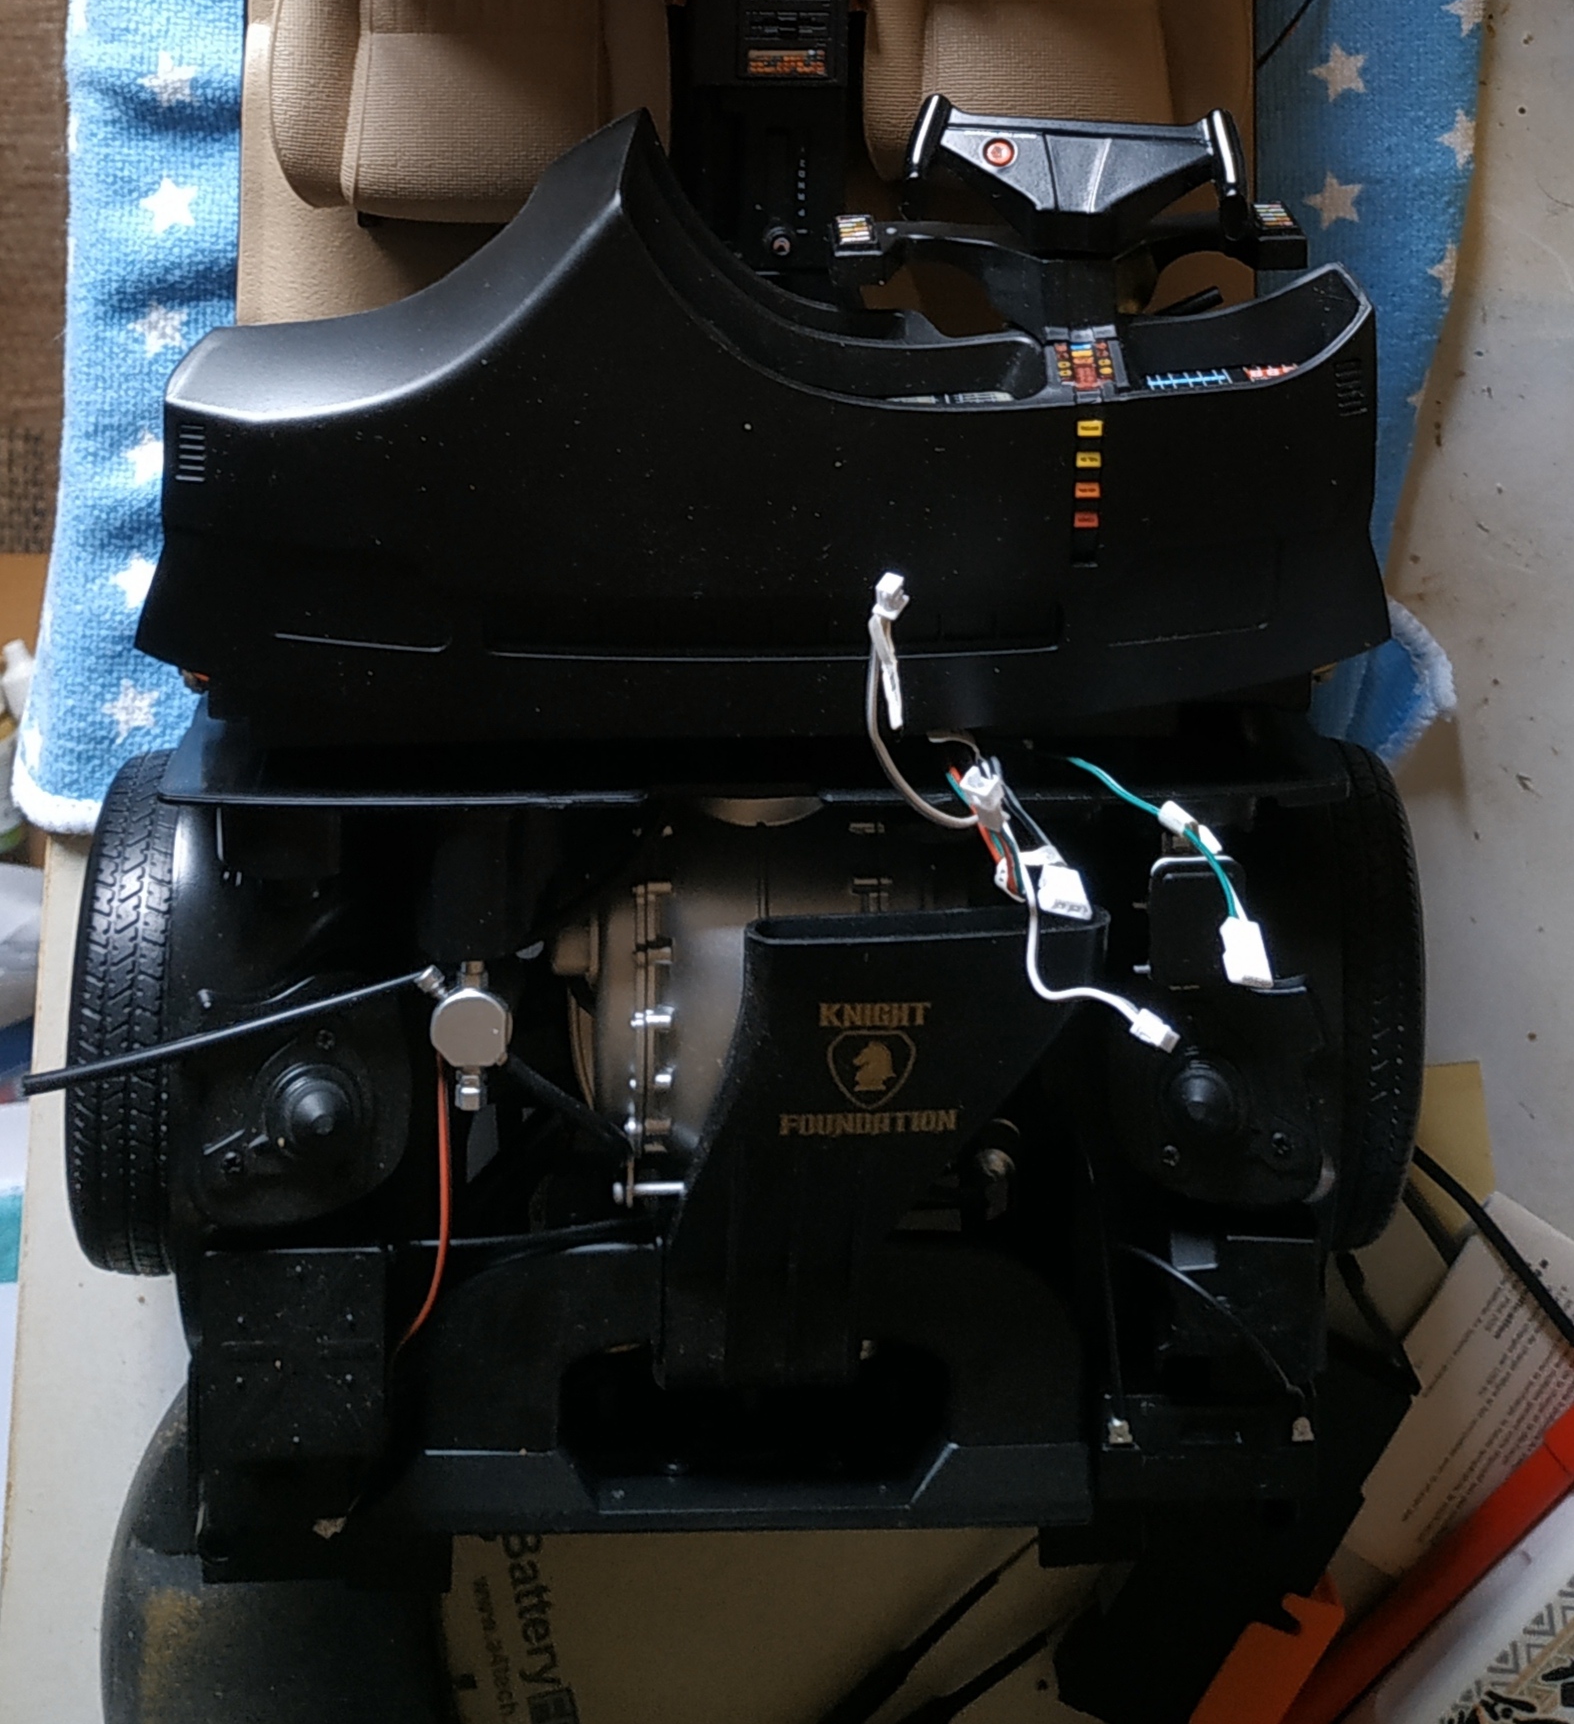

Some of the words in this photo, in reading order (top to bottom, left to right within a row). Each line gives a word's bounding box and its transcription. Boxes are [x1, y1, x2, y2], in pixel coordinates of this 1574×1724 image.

[818, 1002, 932, 1027] KNIGHT
[779, 1108, 958, 1137] FOUNDATION
[502, 1533, 563, 1688] Battery
